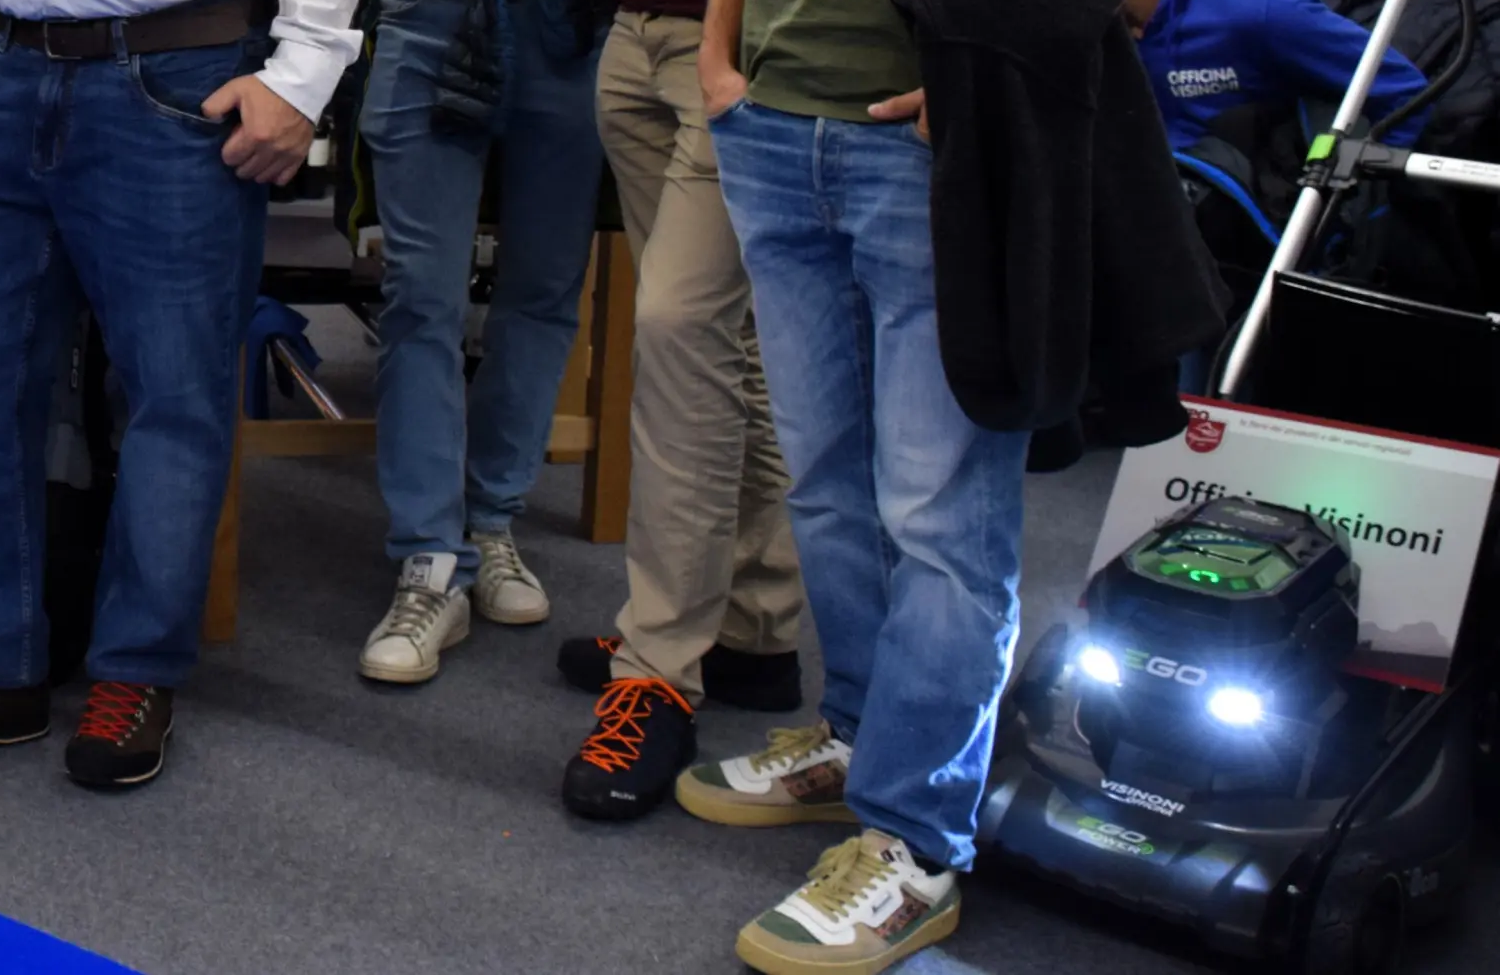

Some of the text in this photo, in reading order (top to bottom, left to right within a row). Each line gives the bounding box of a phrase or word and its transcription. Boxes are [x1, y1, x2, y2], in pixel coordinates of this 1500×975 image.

[1166, 67, 1238, 85] OFFICINA
[1125, 648, 1208, 687] EGO
[1100, 778, 1185, 813] VISINONI
